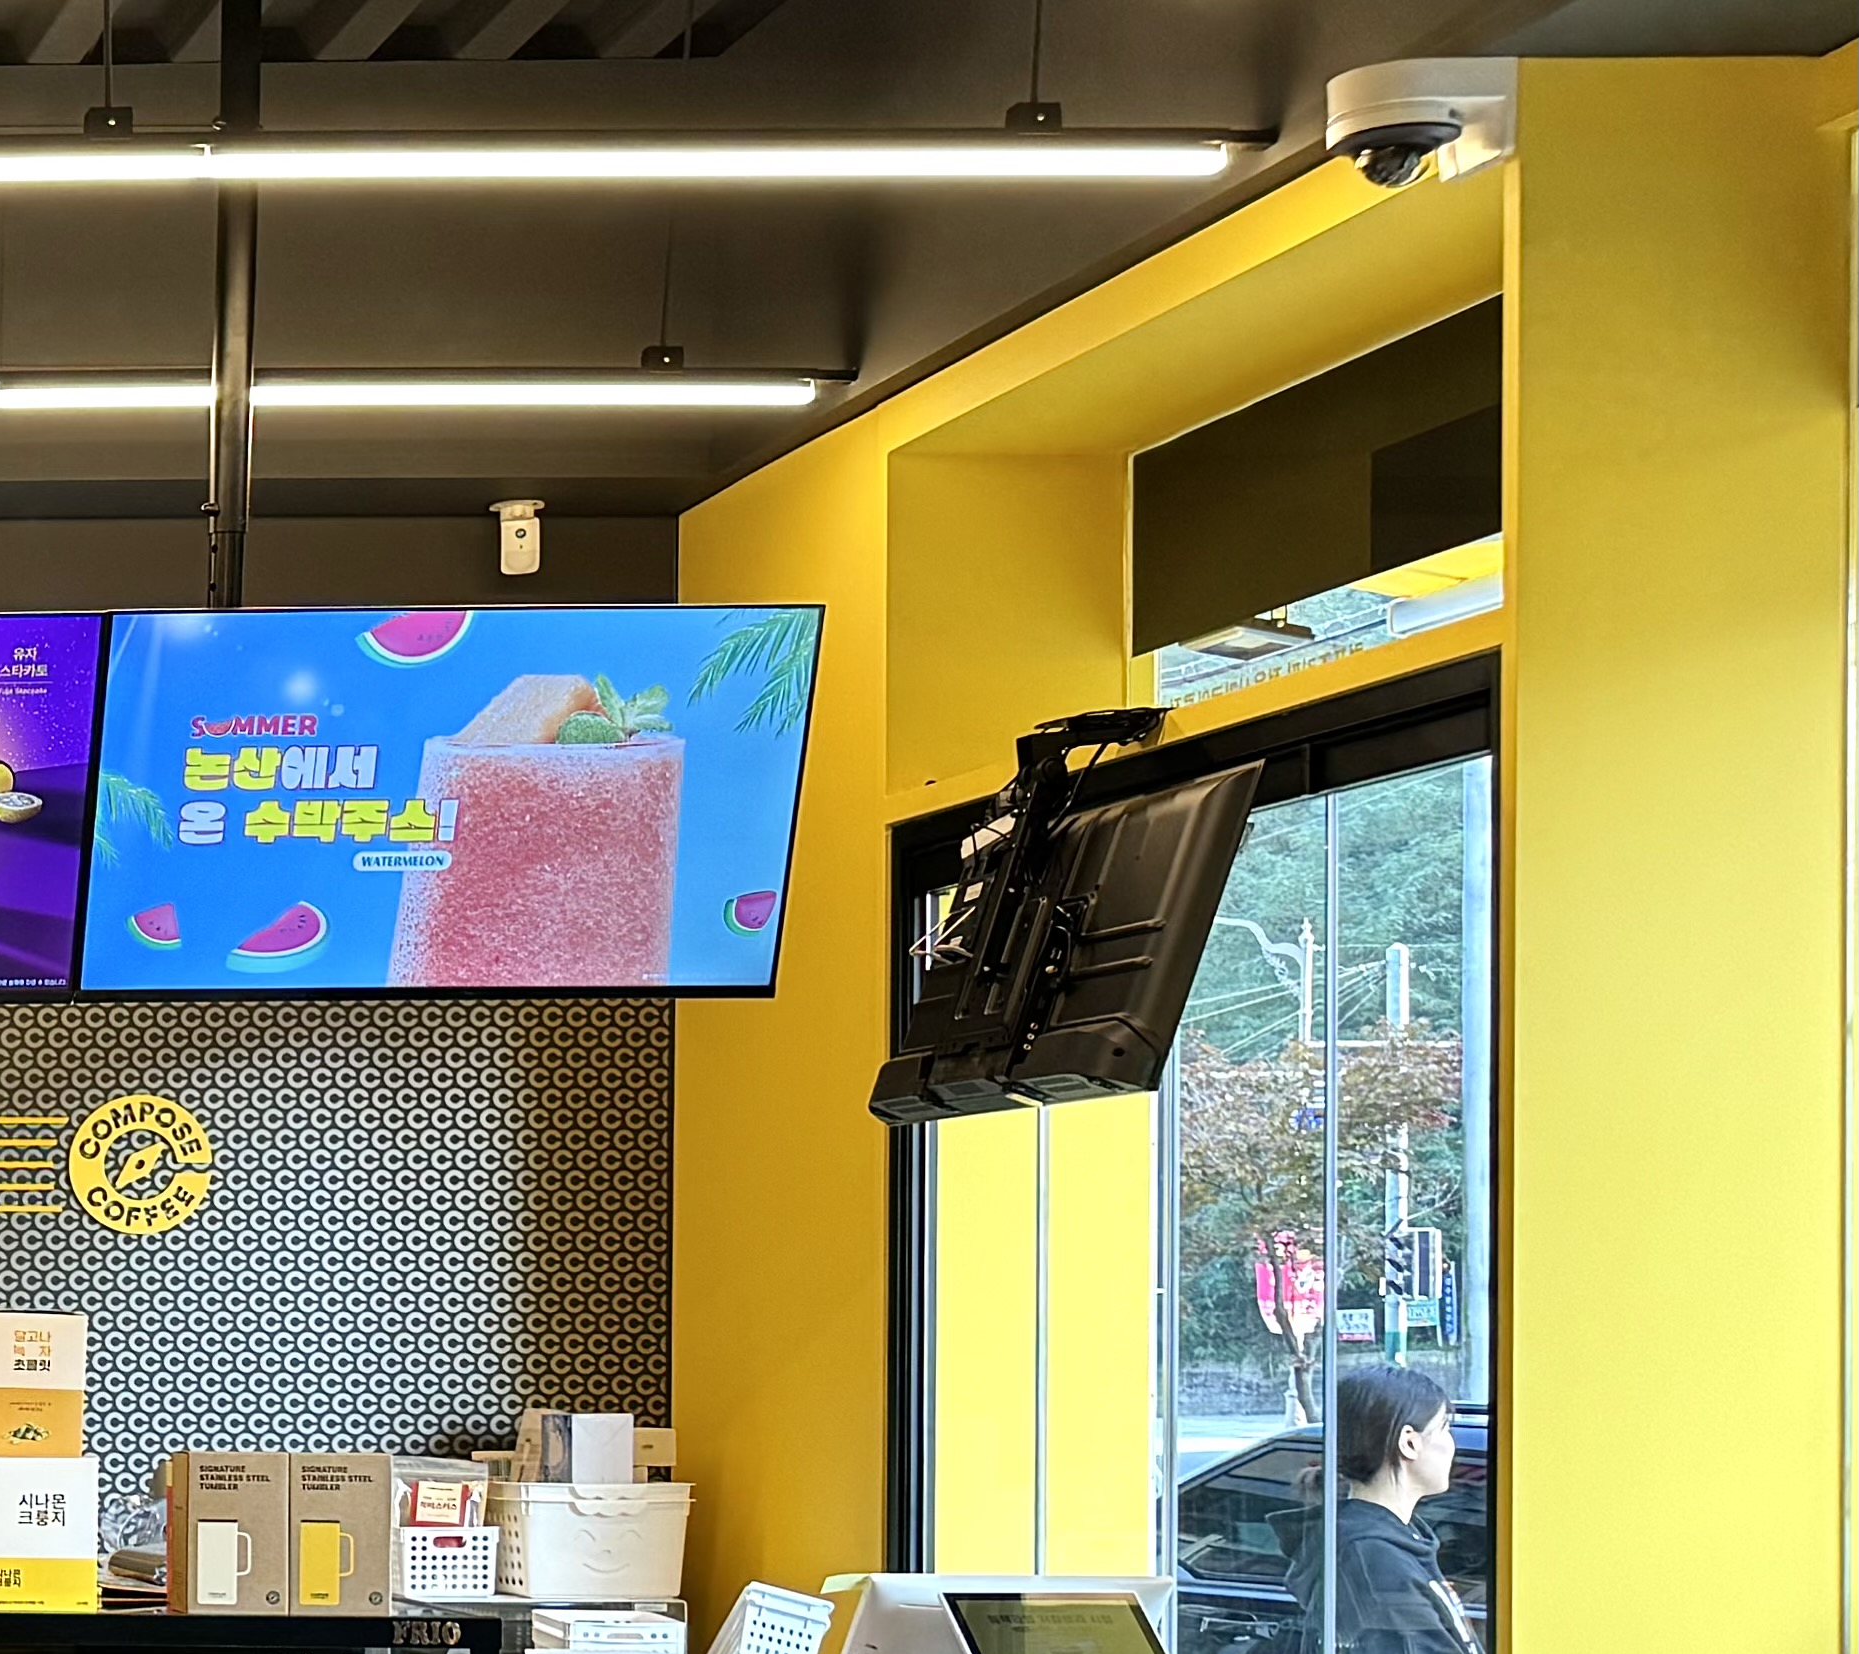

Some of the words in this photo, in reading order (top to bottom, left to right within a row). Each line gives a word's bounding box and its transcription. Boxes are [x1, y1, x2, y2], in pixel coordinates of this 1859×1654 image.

[13, 647, 37, 661] 유자
[184, 745, 378, 791] 논산에서
[179, 800, 227, 844] 온
[243, 799, 459, 843] 수박주스!
[362, 856, 445, 868] WATERMELON
[79, 1101, 202, 1160] COMPOSE
[87, 1186, 195, 1227] COFFEE
[199, 1465, 246, 1473] SIGNATURE
[199, 1474, 244, 1482] STAINLESS
[246, 1474, 271, 1482] STEEL
[348, 1475, 373, 1483] STEEL
[19, 1493, 66, 1510] 시나몬
[392, 1620, 461, 1645] FRIO
